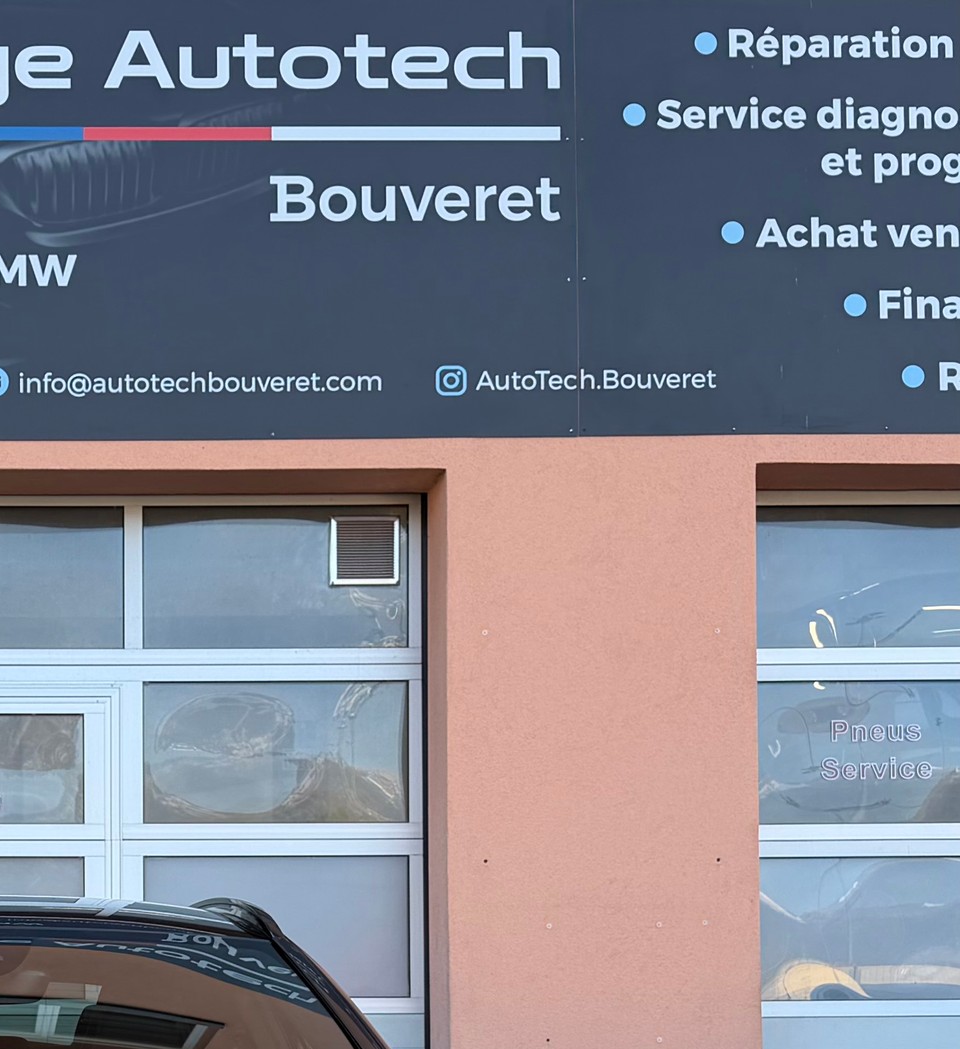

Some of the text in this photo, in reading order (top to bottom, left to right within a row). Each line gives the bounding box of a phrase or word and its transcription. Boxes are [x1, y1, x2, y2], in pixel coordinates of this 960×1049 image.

[103, 30, 562, 91] Autotech
[727, 26, 955, 67] Réparation
[656, 97, 959, 138] Service diagno
[820, 149, 960, 185] et prog
[269, 175, 562, 223] Bouveret
[755, 217, 960, 249] Achat ven
[878, 286, 960, 320] Fina
[18, 370, 383, 398] info@autotechbouveret.com
[475, 368, 718, 392] AutoTech.Bouveret
[830, 719, 922, 743] Pneus
[820, 756, 933, 781] Service
